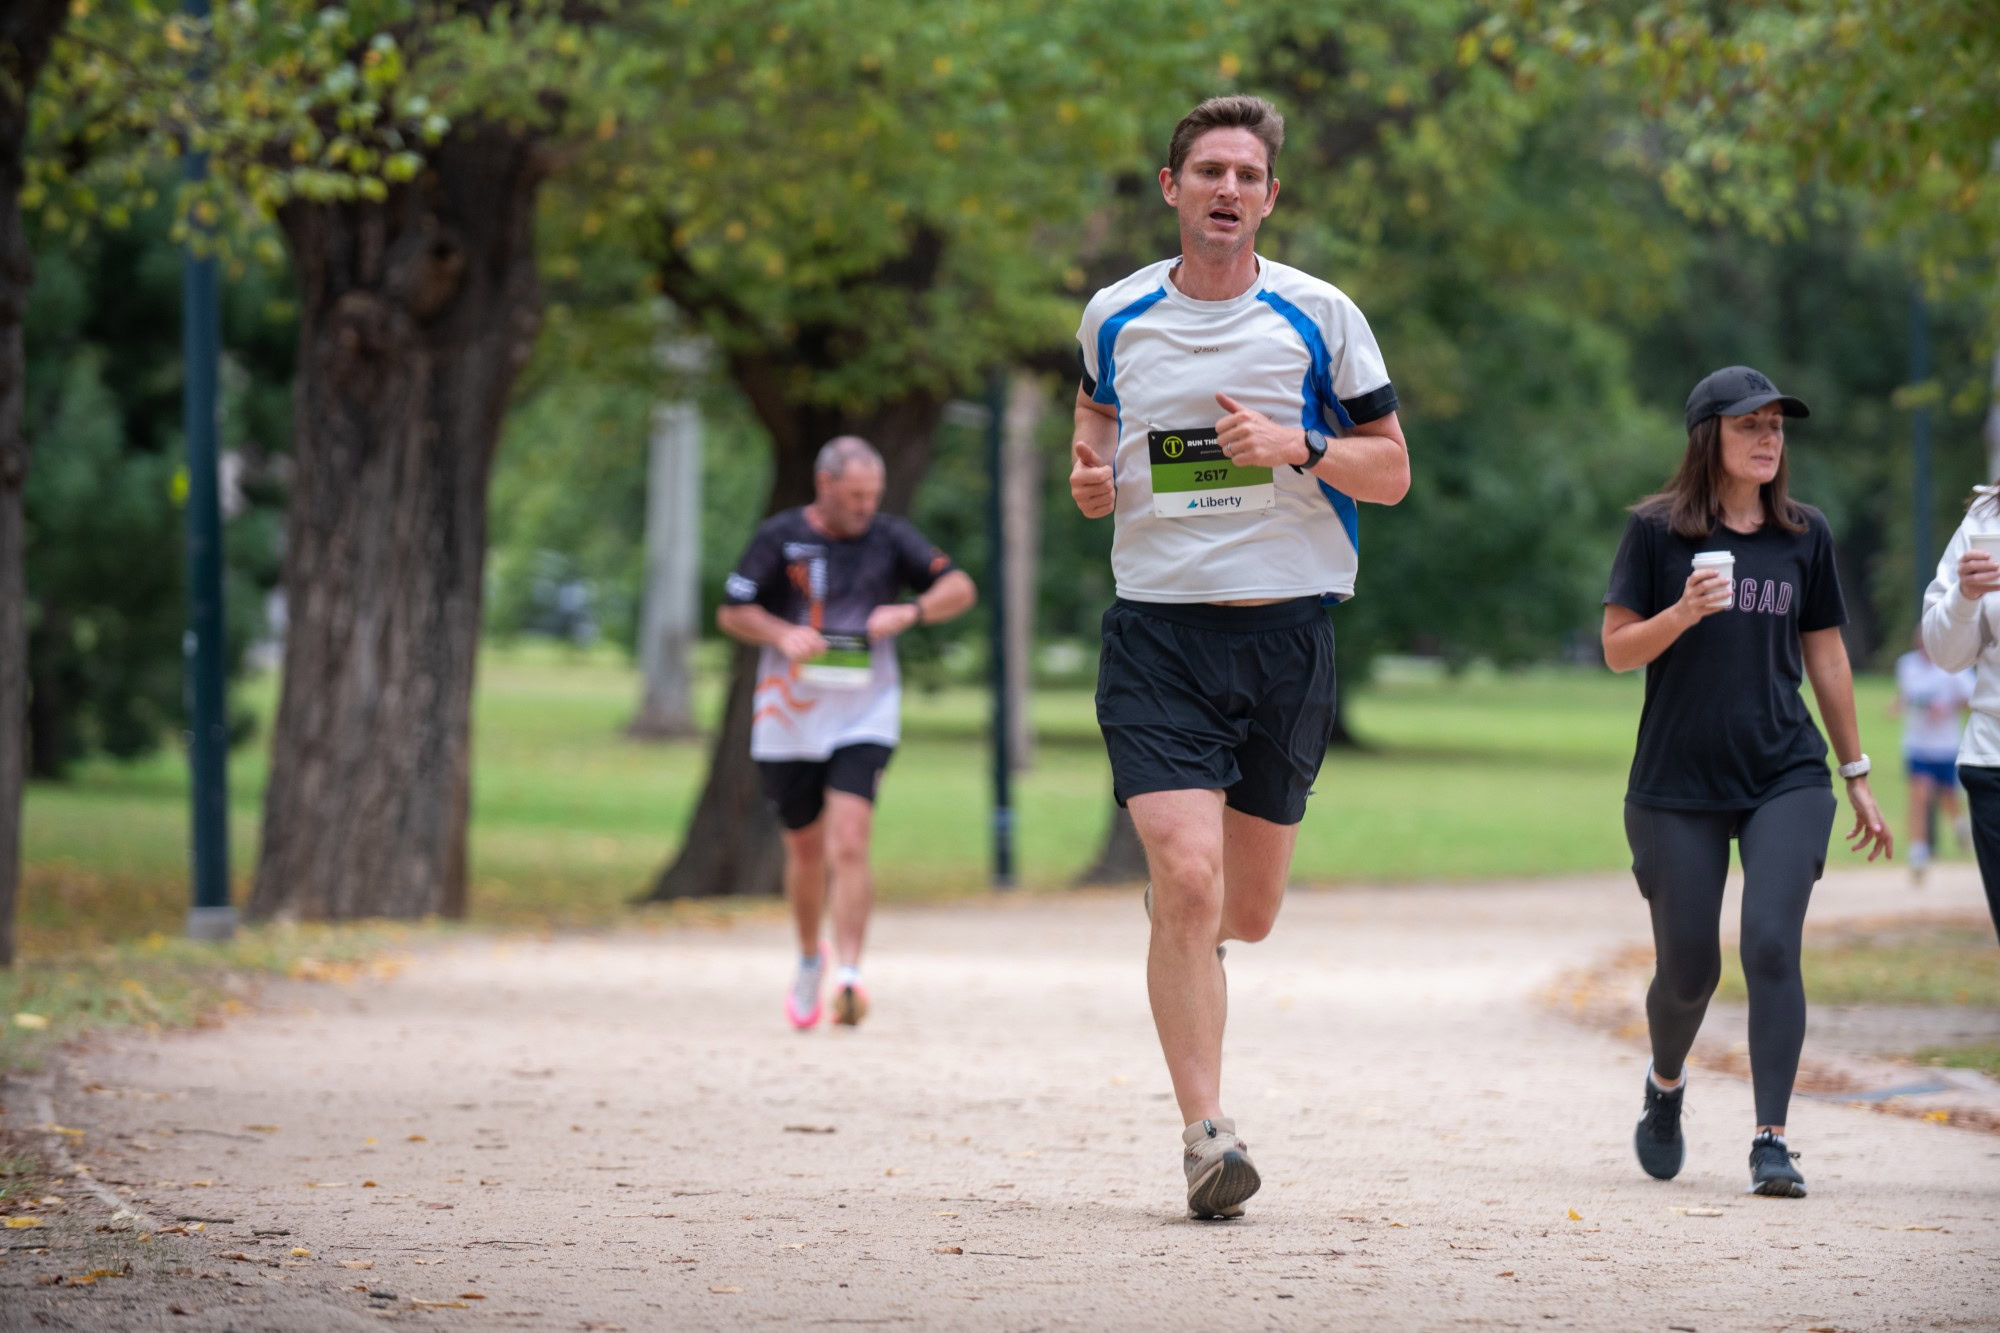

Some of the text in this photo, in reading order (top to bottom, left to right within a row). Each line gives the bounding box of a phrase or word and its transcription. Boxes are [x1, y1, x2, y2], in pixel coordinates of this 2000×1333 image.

[1187, 439, 1203, 447] RUN
[1194, 469, 1228, 482] 2617
[1200, 496, 1242, 508] Liberty
